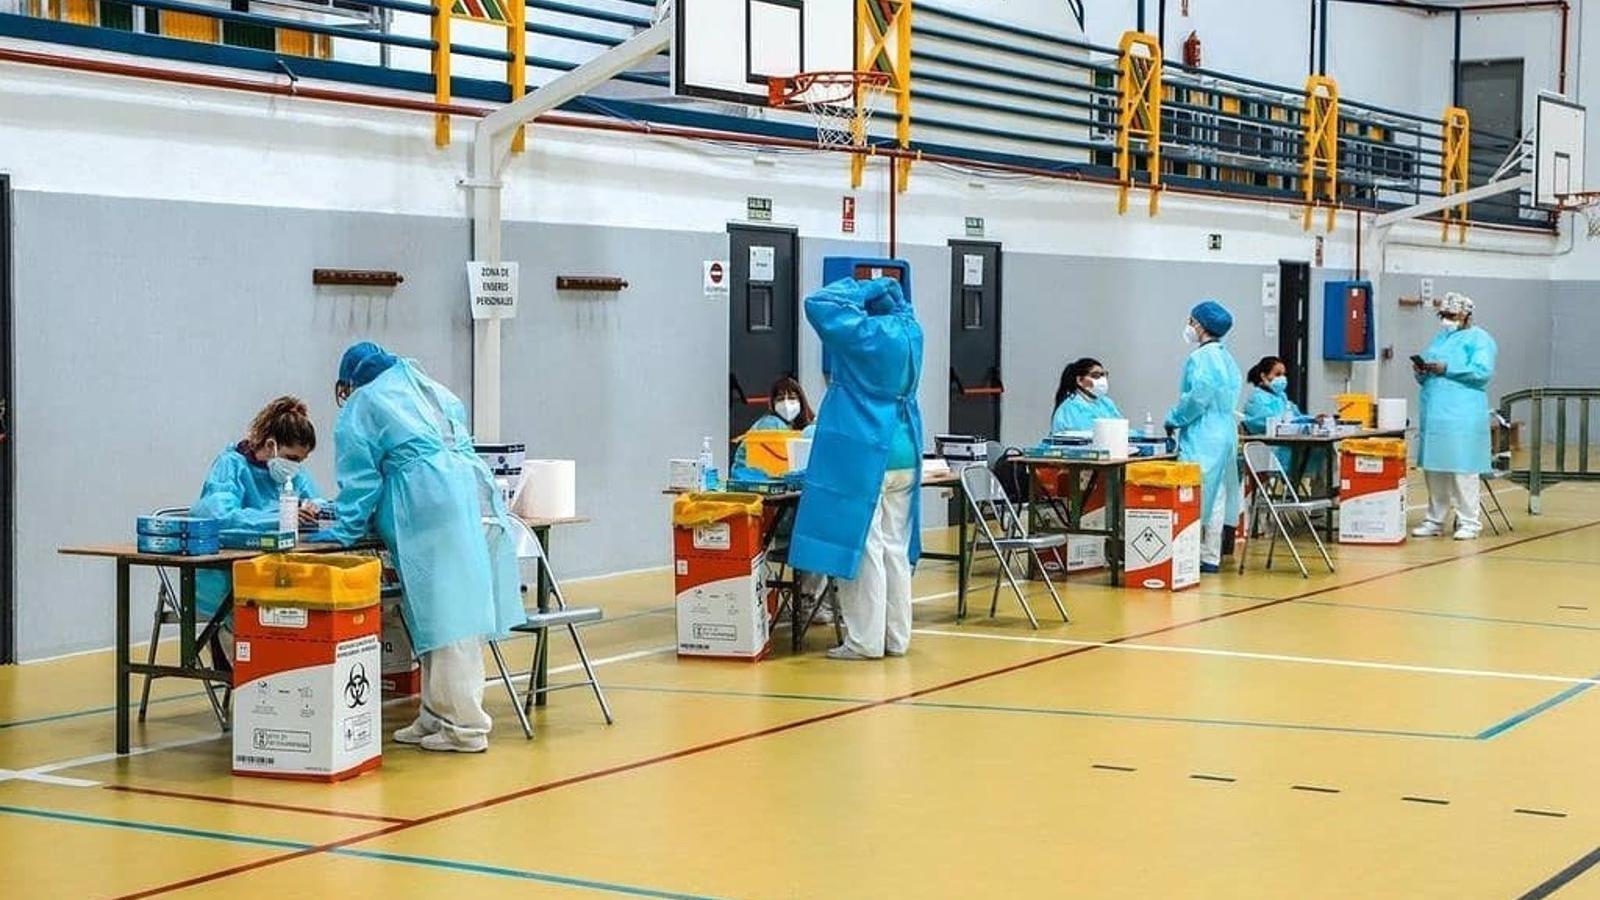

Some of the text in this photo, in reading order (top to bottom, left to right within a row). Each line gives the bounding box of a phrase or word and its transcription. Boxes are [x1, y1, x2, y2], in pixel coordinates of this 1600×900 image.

[481, 267, 509, 277] ZONA DE
[476, 296, 513, 306] PERSONALES
